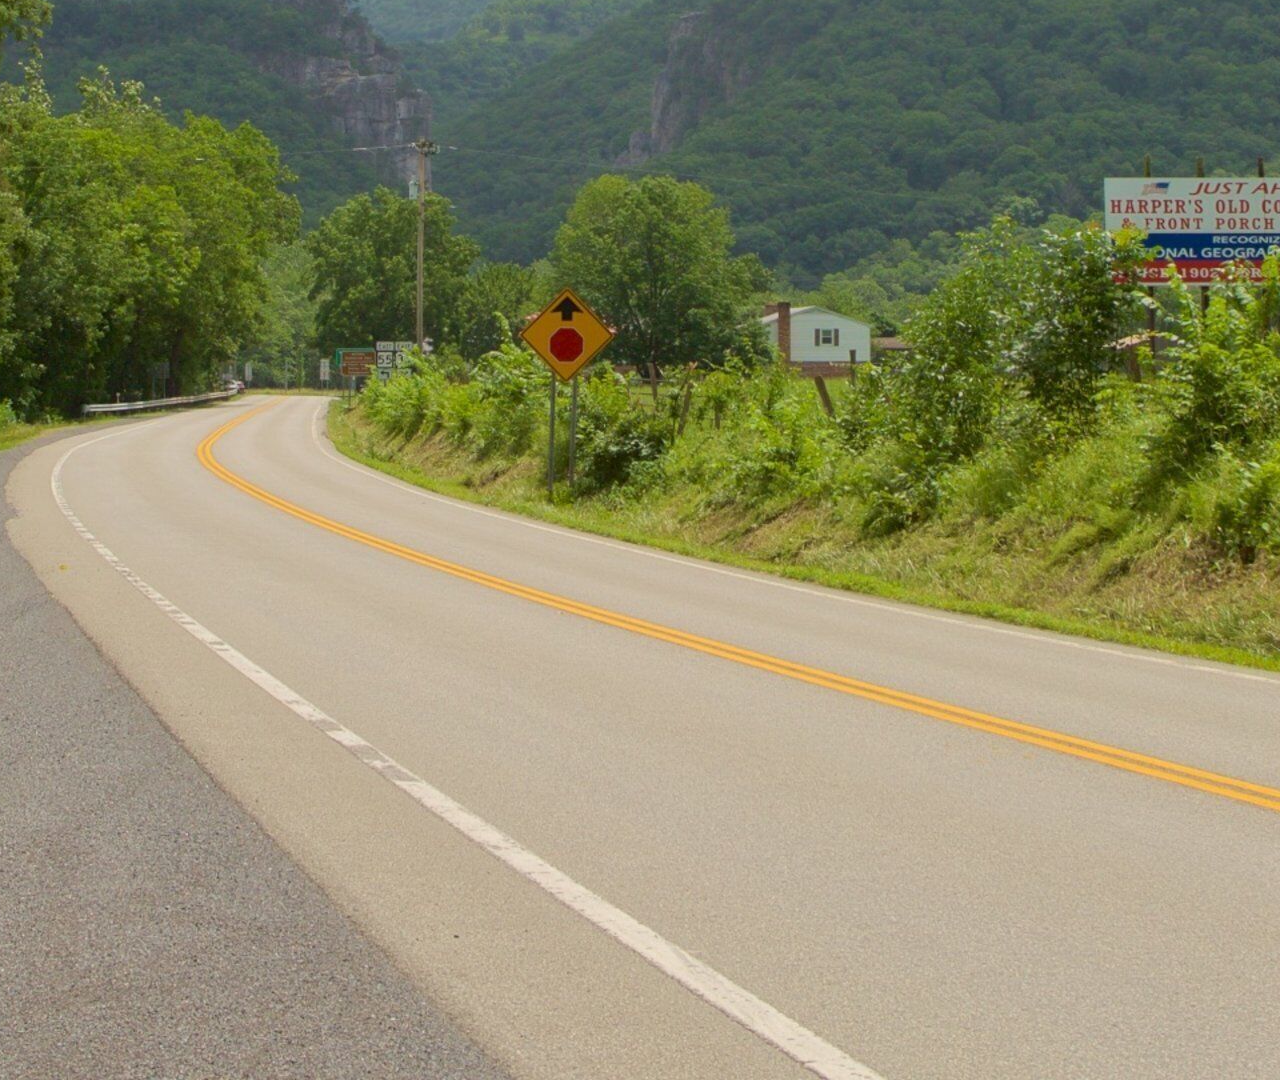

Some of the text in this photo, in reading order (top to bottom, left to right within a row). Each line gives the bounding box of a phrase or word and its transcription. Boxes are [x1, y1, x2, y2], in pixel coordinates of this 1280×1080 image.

[1189, 182, 1248, 196] JUST
[1110, 199, 1204, 214] HARPER'S
[1215, 199, 1250, 214] OLD
[1145, 217, 1204, 230] FRONT
[1215, 217, 1274, 230] PORCH
[378, 354, 392, 364] 55
